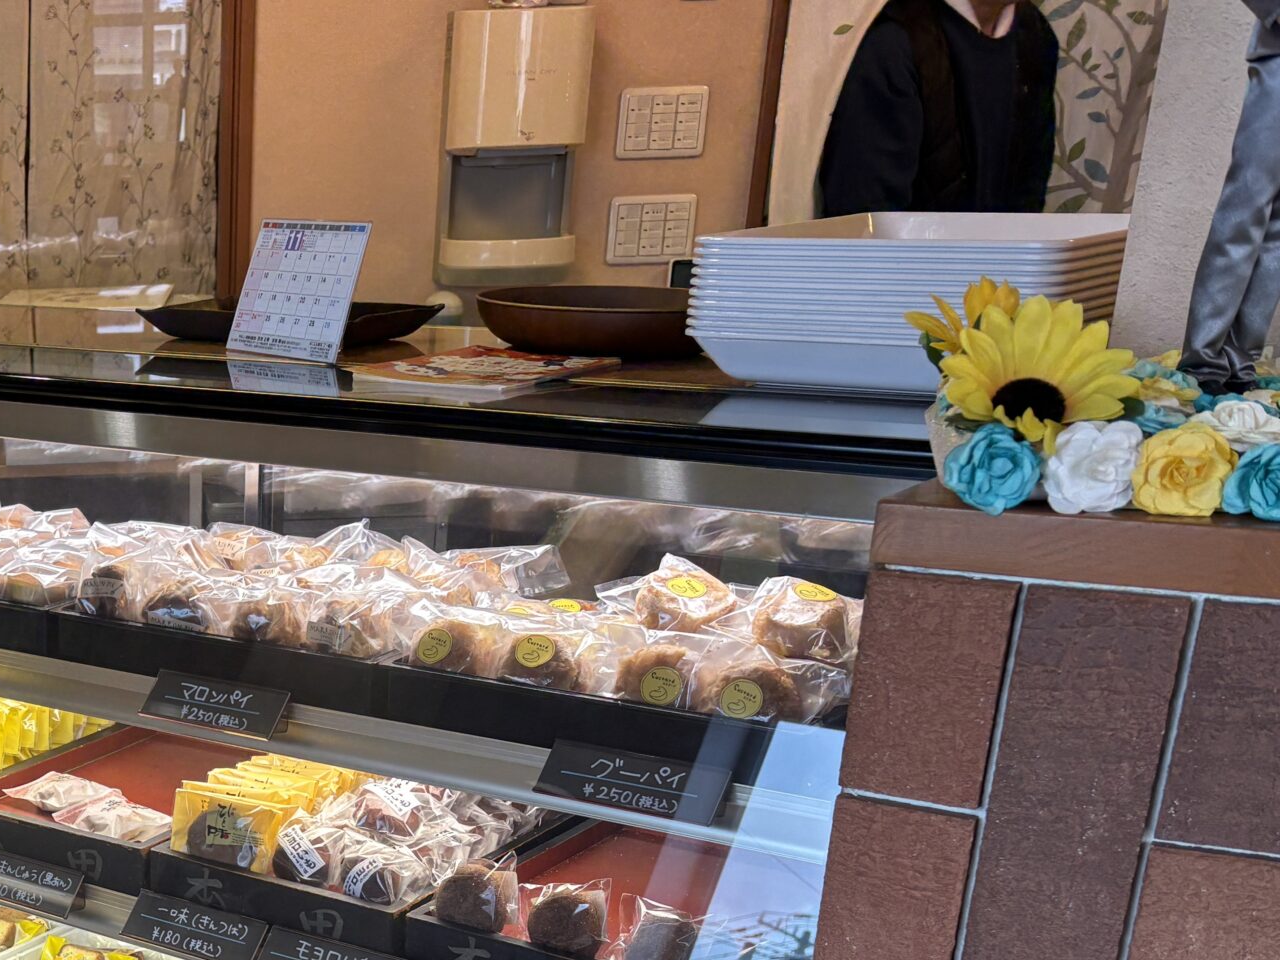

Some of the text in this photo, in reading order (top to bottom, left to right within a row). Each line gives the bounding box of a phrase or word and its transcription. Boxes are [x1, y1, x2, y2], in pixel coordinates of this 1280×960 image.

[180, 682, 253, 709] マロンパイ
[180, 704, 248, 731] ¥250(税込)
[591, 758, 687, 788] グーパイ
[582, 783, 678, 814] ¥250(税込)
[152, 926, 222, 958] ¥180(税込)
